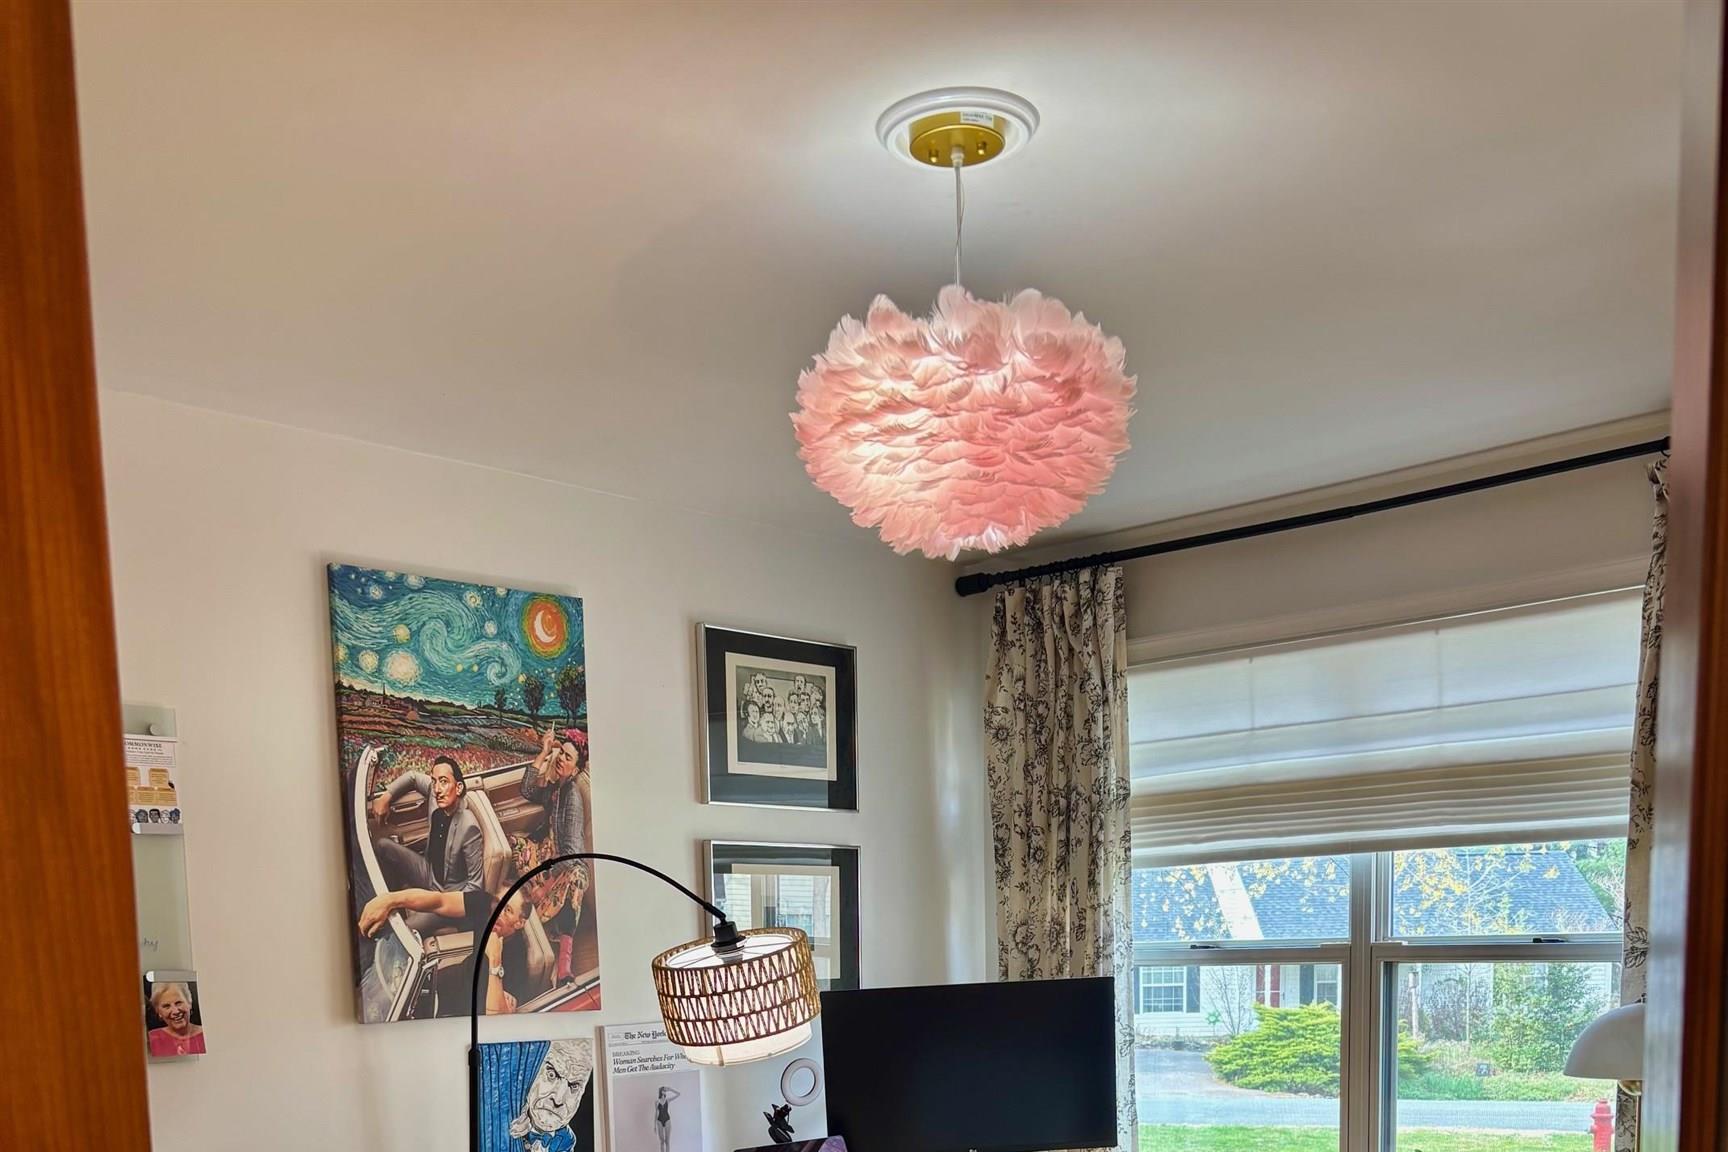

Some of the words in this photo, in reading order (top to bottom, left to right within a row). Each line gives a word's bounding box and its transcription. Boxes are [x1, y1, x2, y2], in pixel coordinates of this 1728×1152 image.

[624, 1032, 636, 1040] The
[637, 1031, 651, 1039] New
[613, 1057, 637, 1065] Woman
[637, 1055, 663, 1063] Searches
[627, 1065, 637, 1073] Get
[639, 1064, 650, 1072] The
[650, 1063, 675, 1071] Audacity
